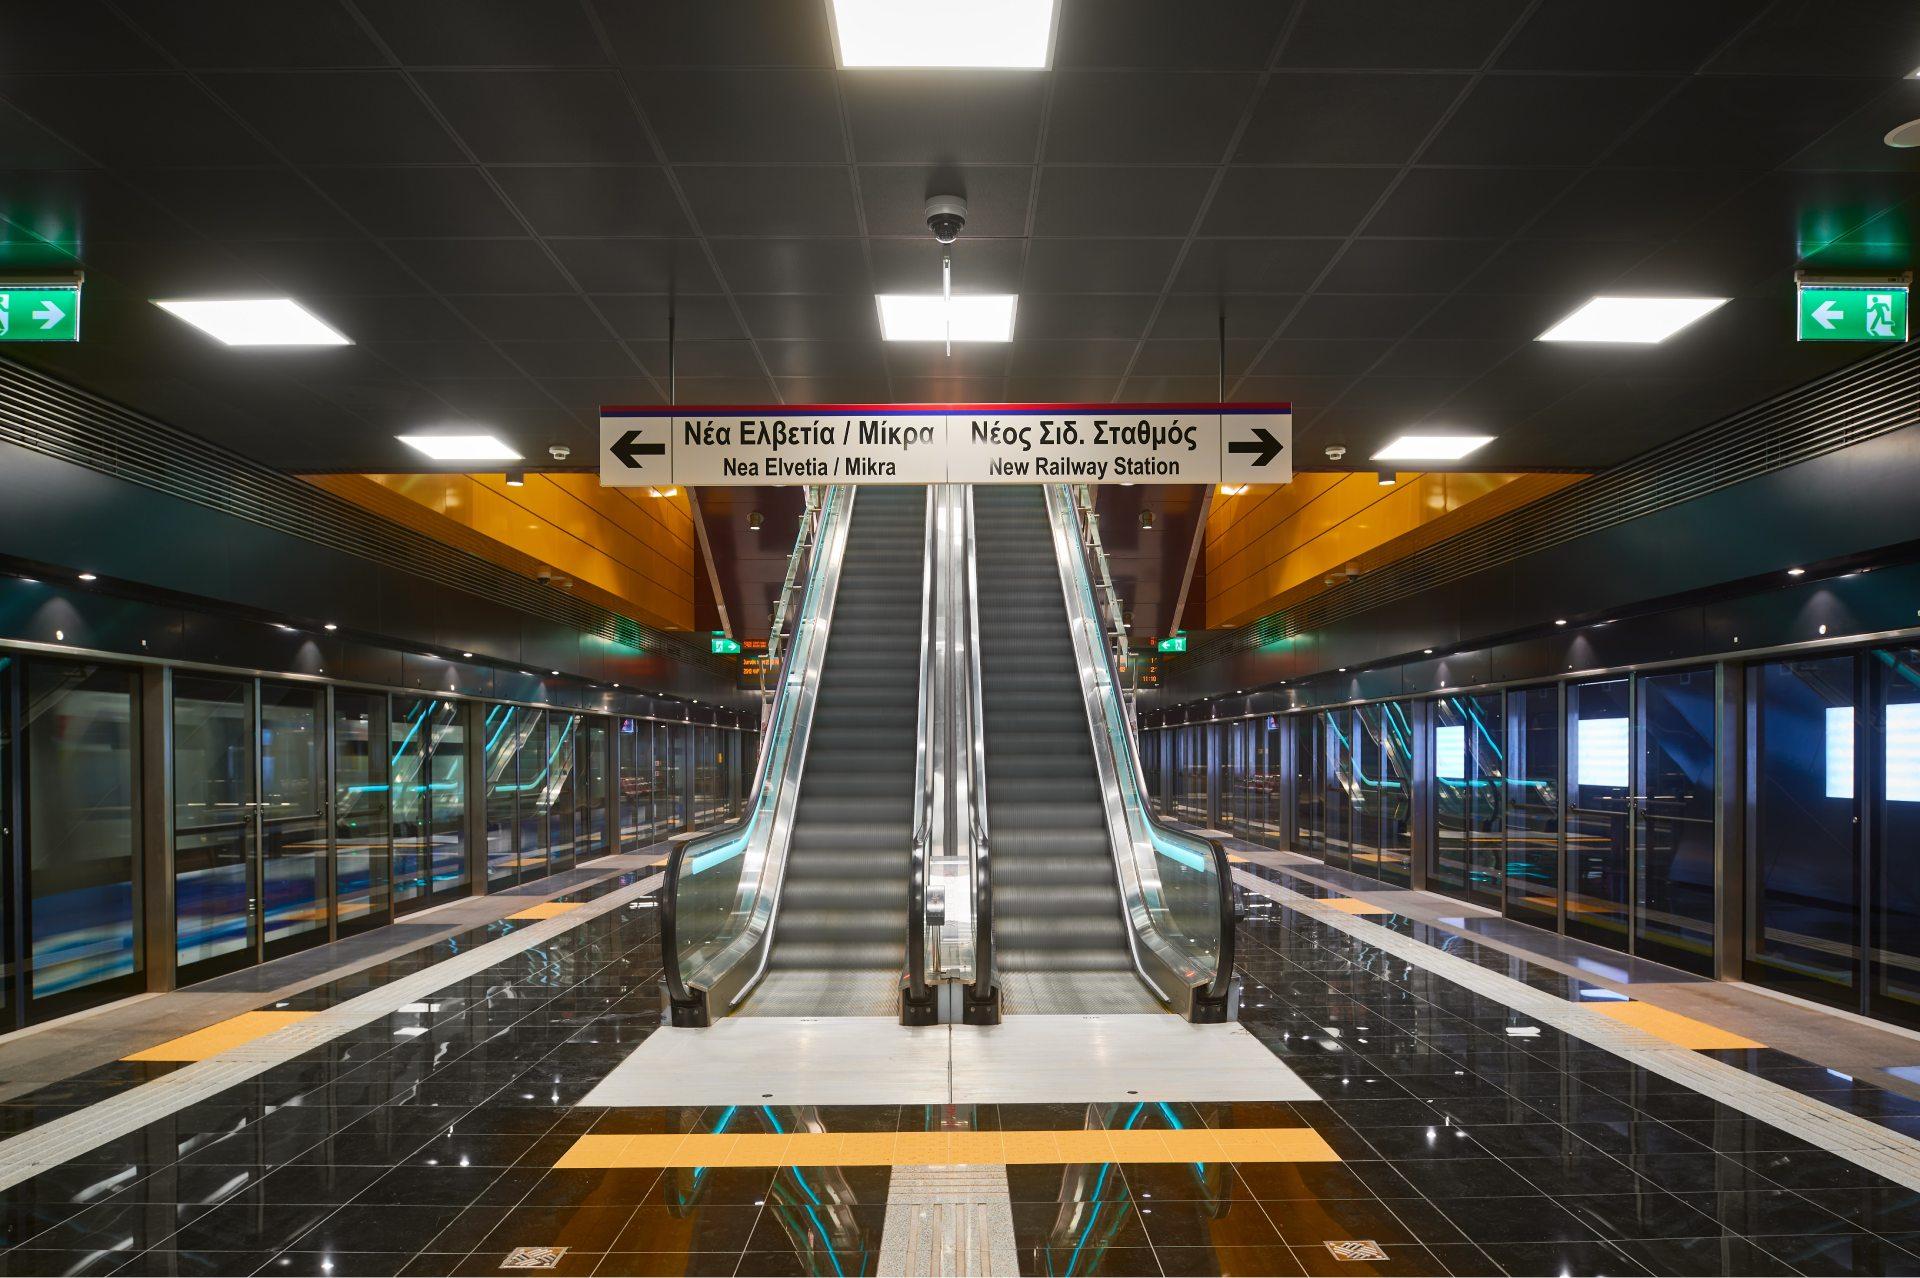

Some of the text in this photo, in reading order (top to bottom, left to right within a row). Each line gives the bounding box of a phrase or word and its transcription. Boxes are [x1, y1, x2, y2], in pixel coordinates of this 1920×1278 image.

[685, 420, 934, 451] Νέα Ελβετία / Μίκρα
[971, 420, 1198, 451] Νέος Σιδ. Σταθμός
[723, 457, 896, 476] Nea Elvetia / Mikra
[989, 457, 1180, 480] New Railway Station
